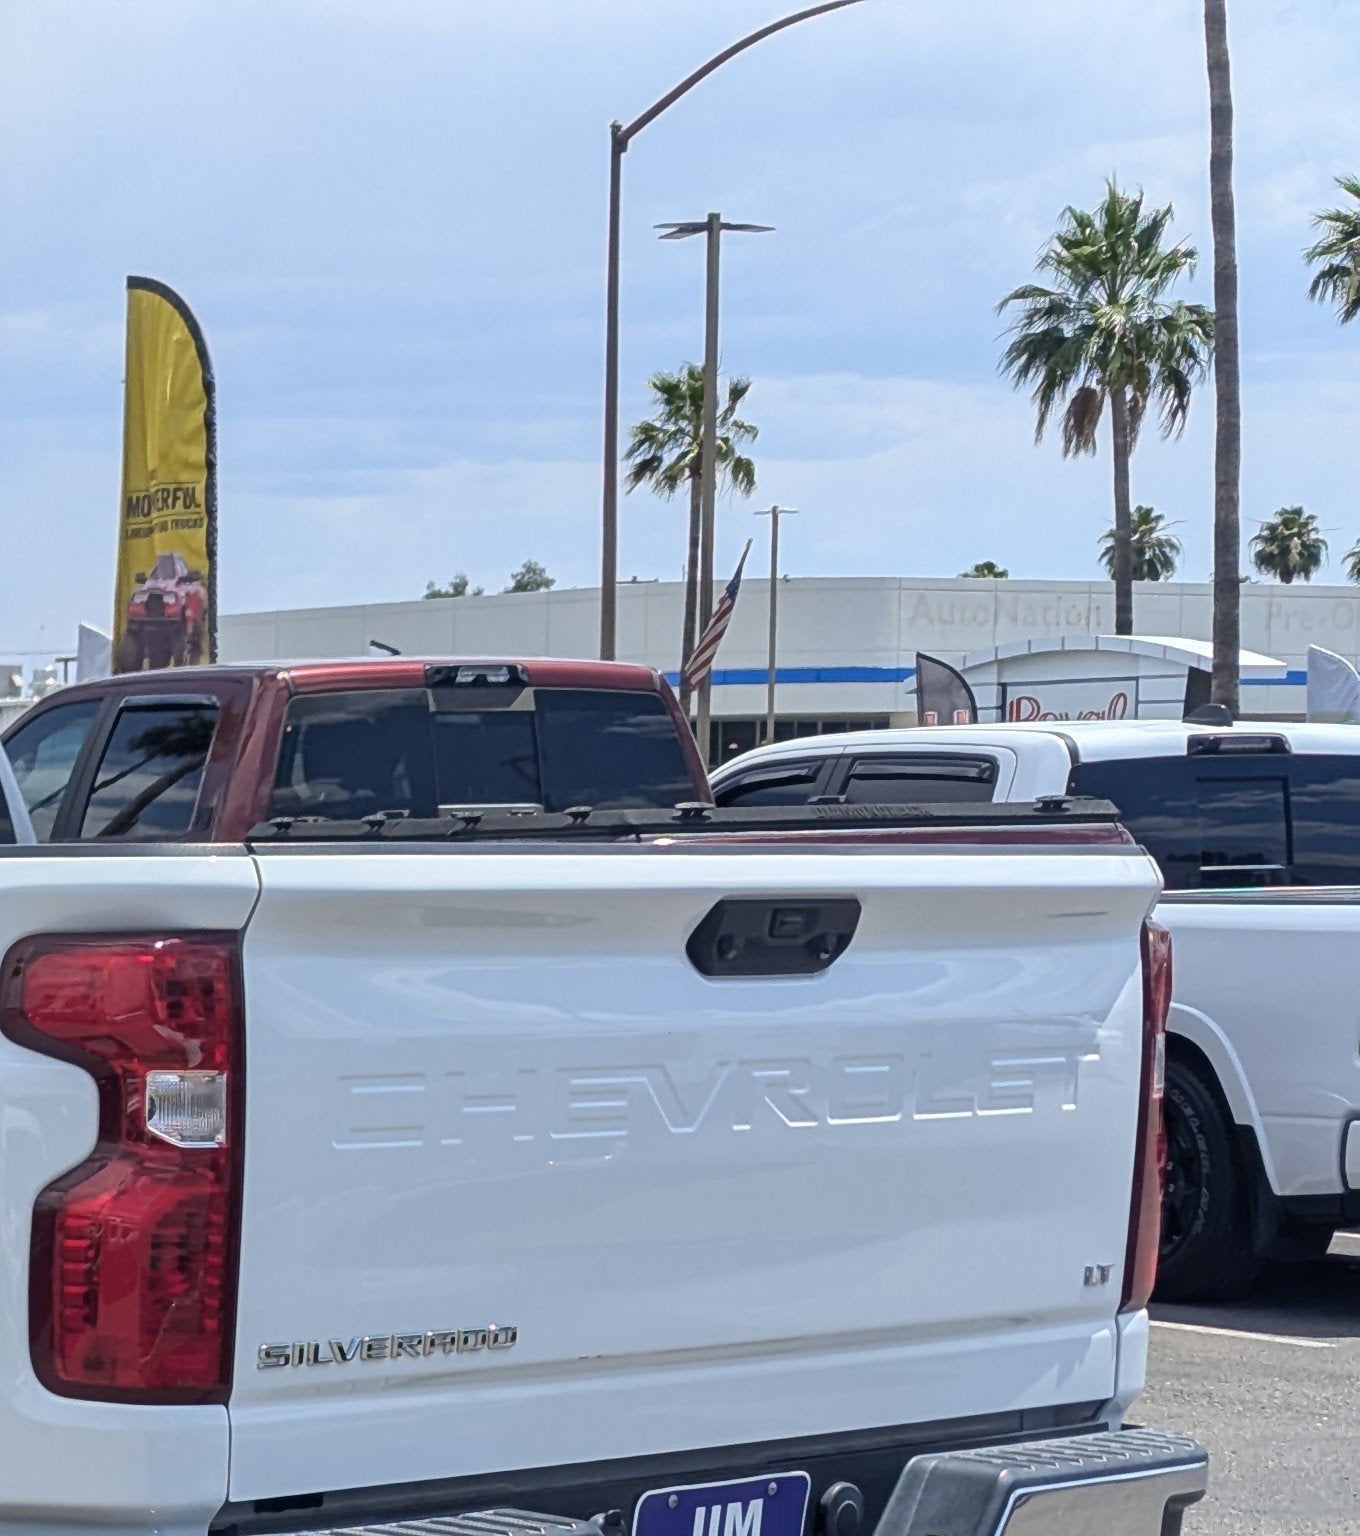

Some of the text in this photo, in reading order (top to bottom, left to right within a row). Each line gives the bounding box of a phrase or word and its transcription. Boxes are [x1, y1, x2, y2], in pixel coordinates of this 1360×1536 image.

[332, 1045, 1101, 1150] CHEVROLET
[1083, 1263, 1115, 1287] LT
[256, 1326, 518, 1370] SILVERADO
